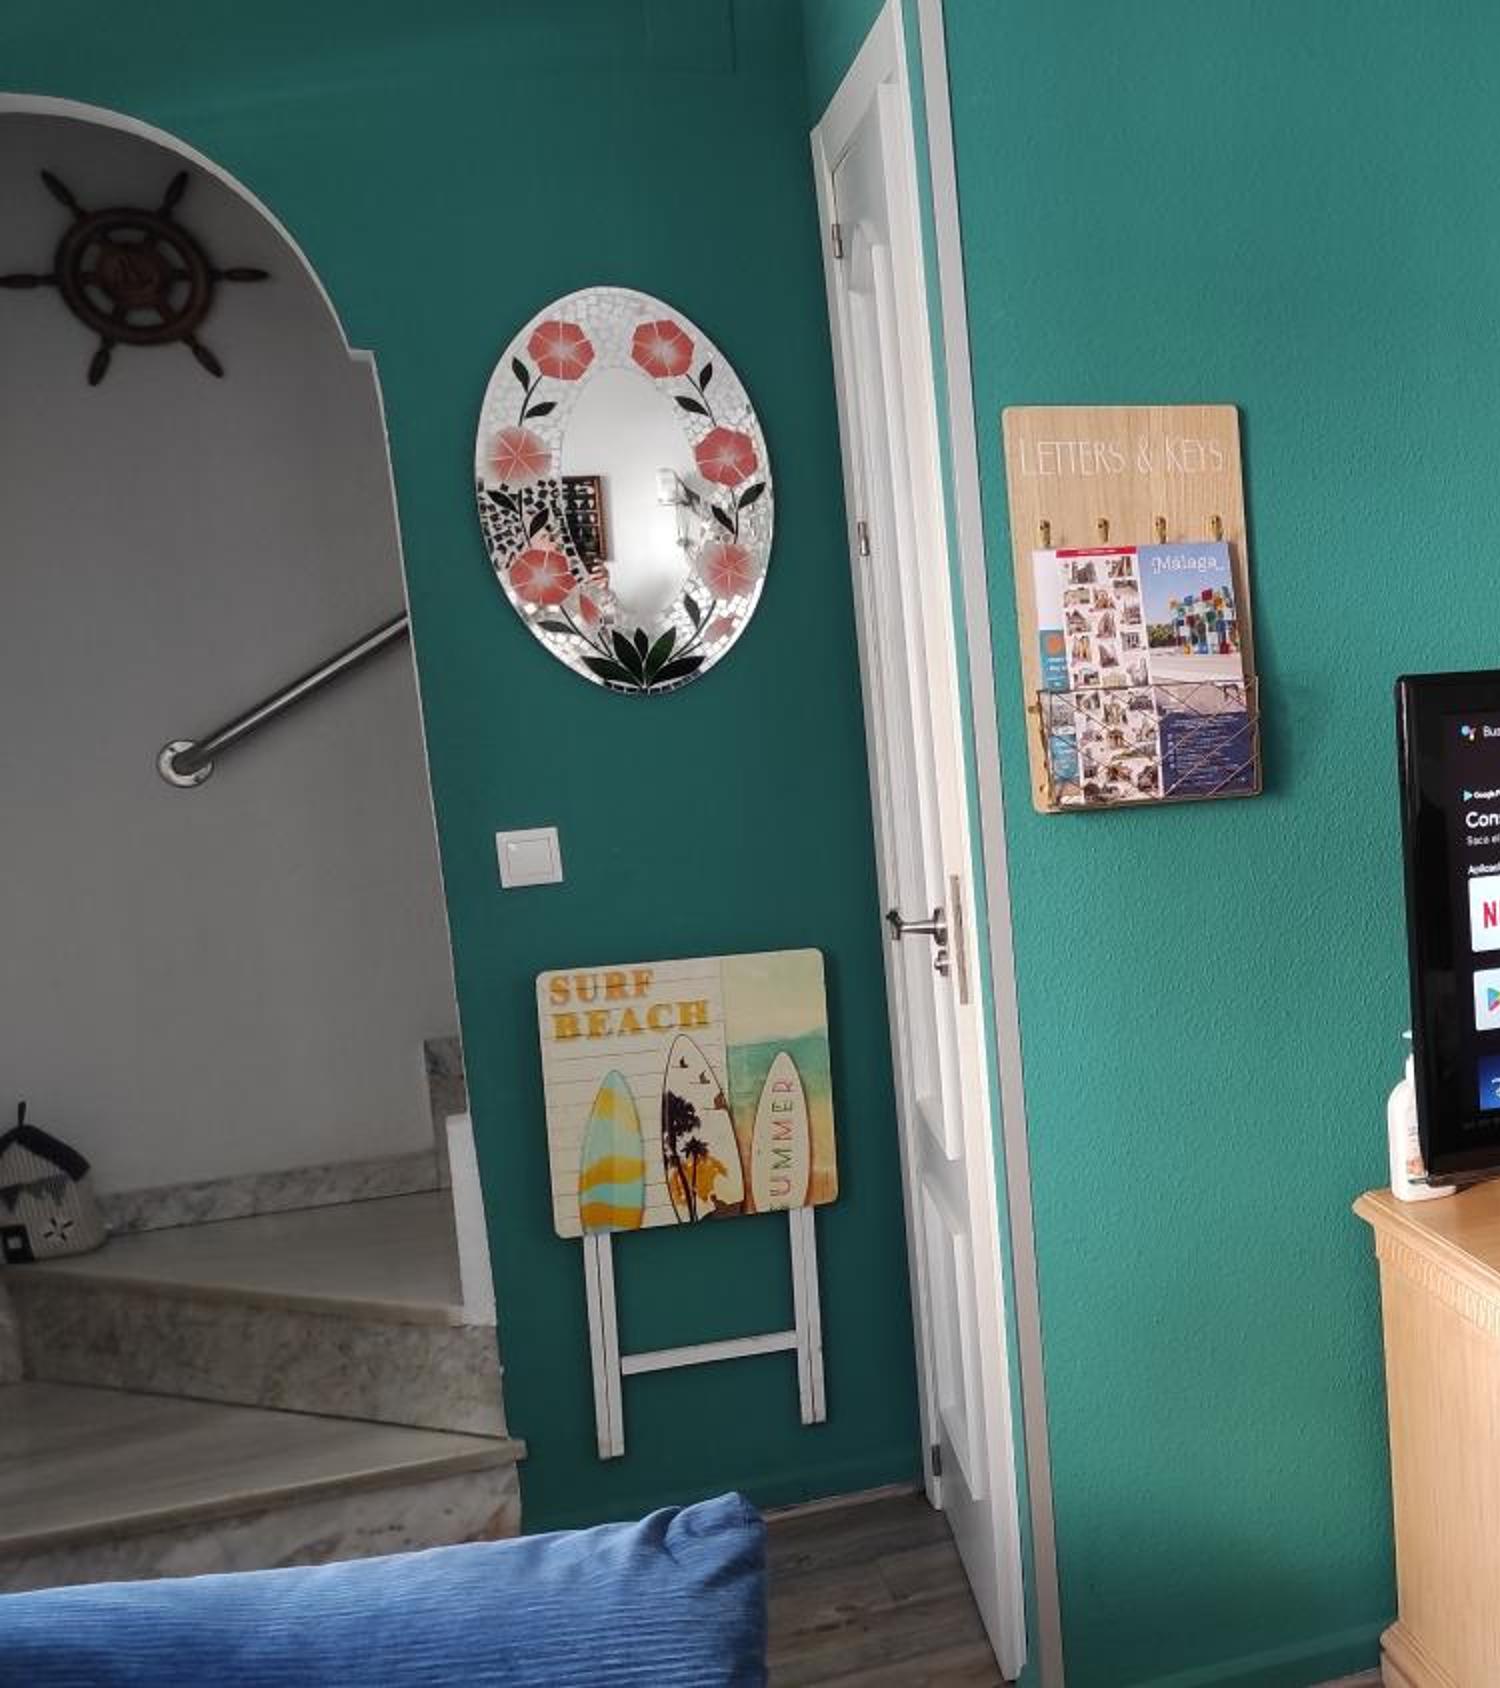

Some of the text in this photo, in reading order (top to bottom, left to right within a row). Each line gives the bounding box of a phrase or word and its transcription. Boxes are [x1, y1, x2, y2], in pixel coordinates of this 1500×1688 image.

[1020, 434, 1224, 477] LETTERS & KEYS
[1474, 791, 1494, 800] Google
[550, 968, 654, 1005] SURF
[552, 999, 709, 1041] BEACH
